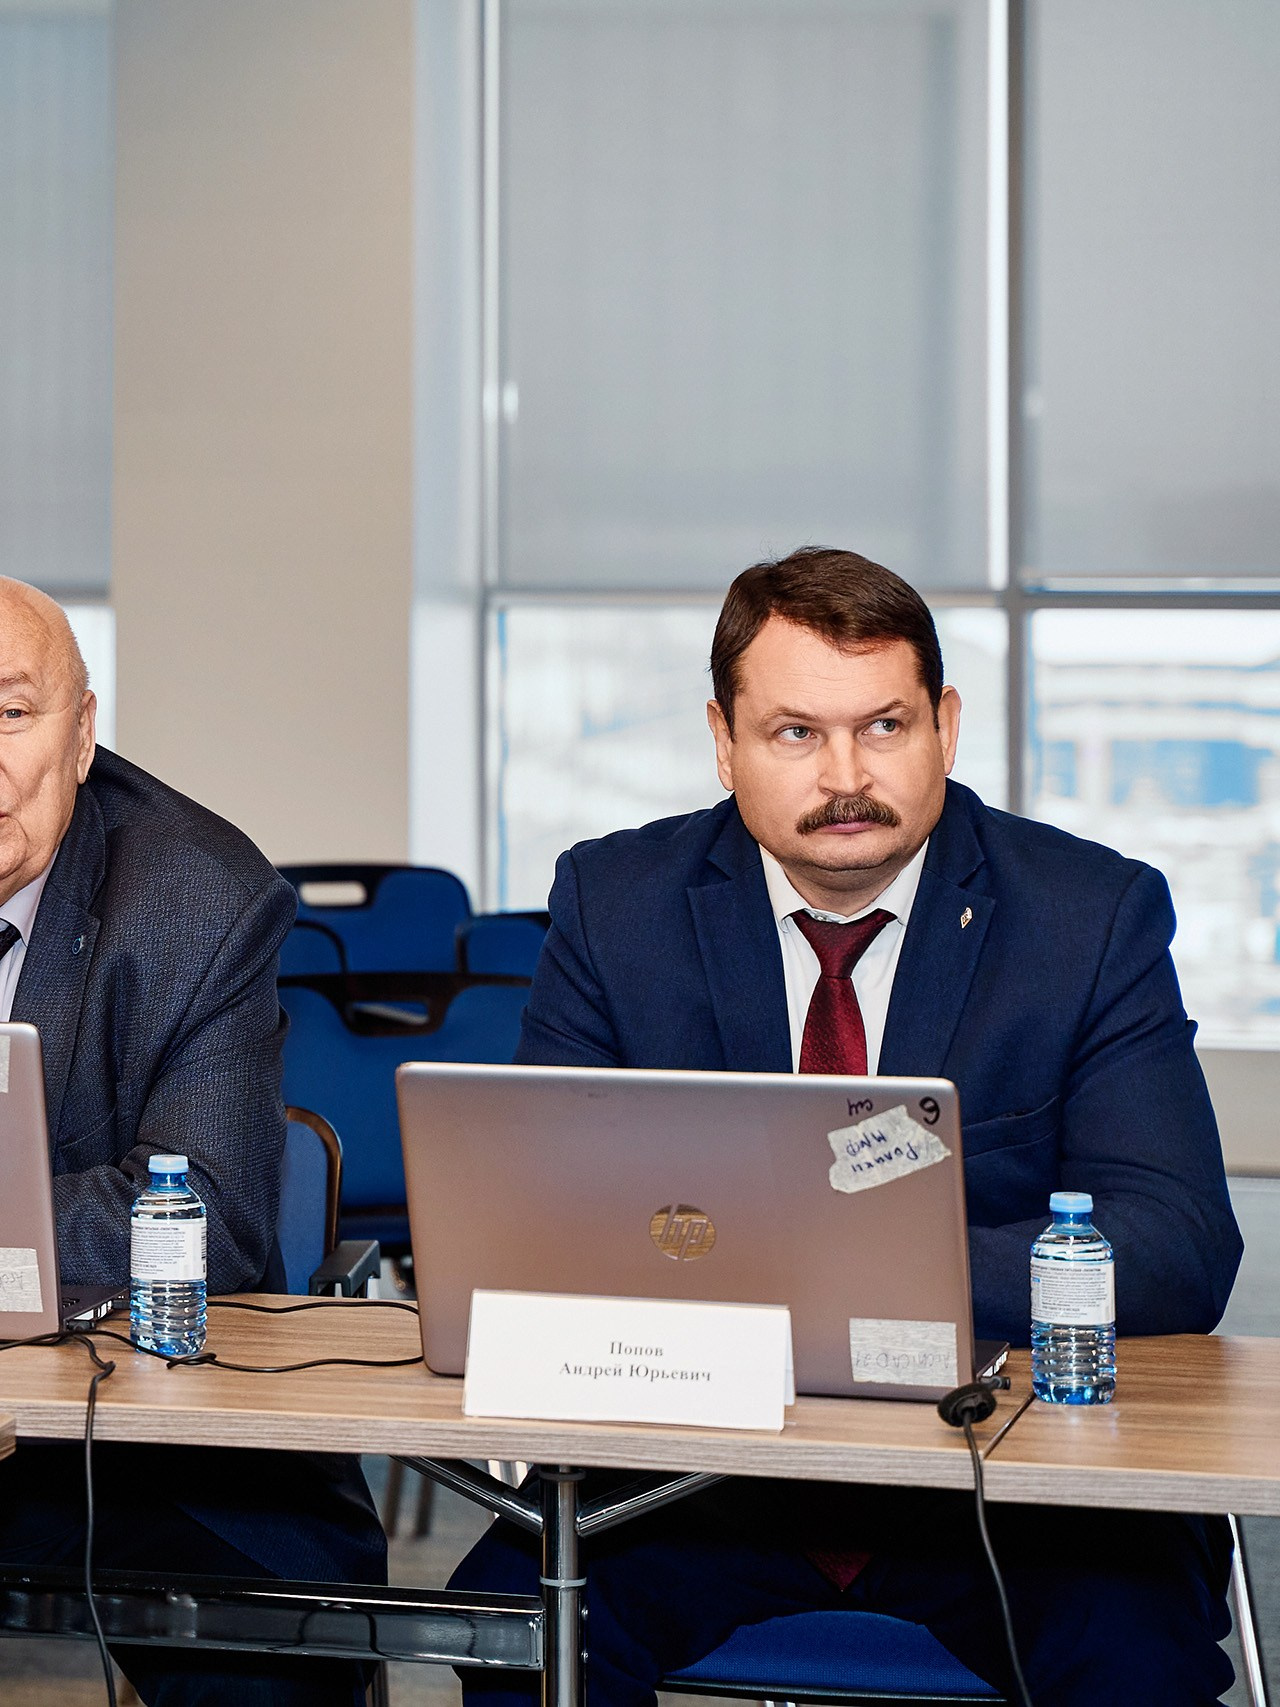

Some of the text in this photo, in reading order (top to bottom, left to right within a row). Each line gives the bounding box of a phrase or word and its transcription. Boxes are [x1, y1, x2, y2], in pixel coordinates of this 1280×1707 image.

[658, 1203, 710, 1261] hp
[610, 1341, 664, 1357] Попов
[559, 1362, 712, 1382] Андрей Юрьевич
